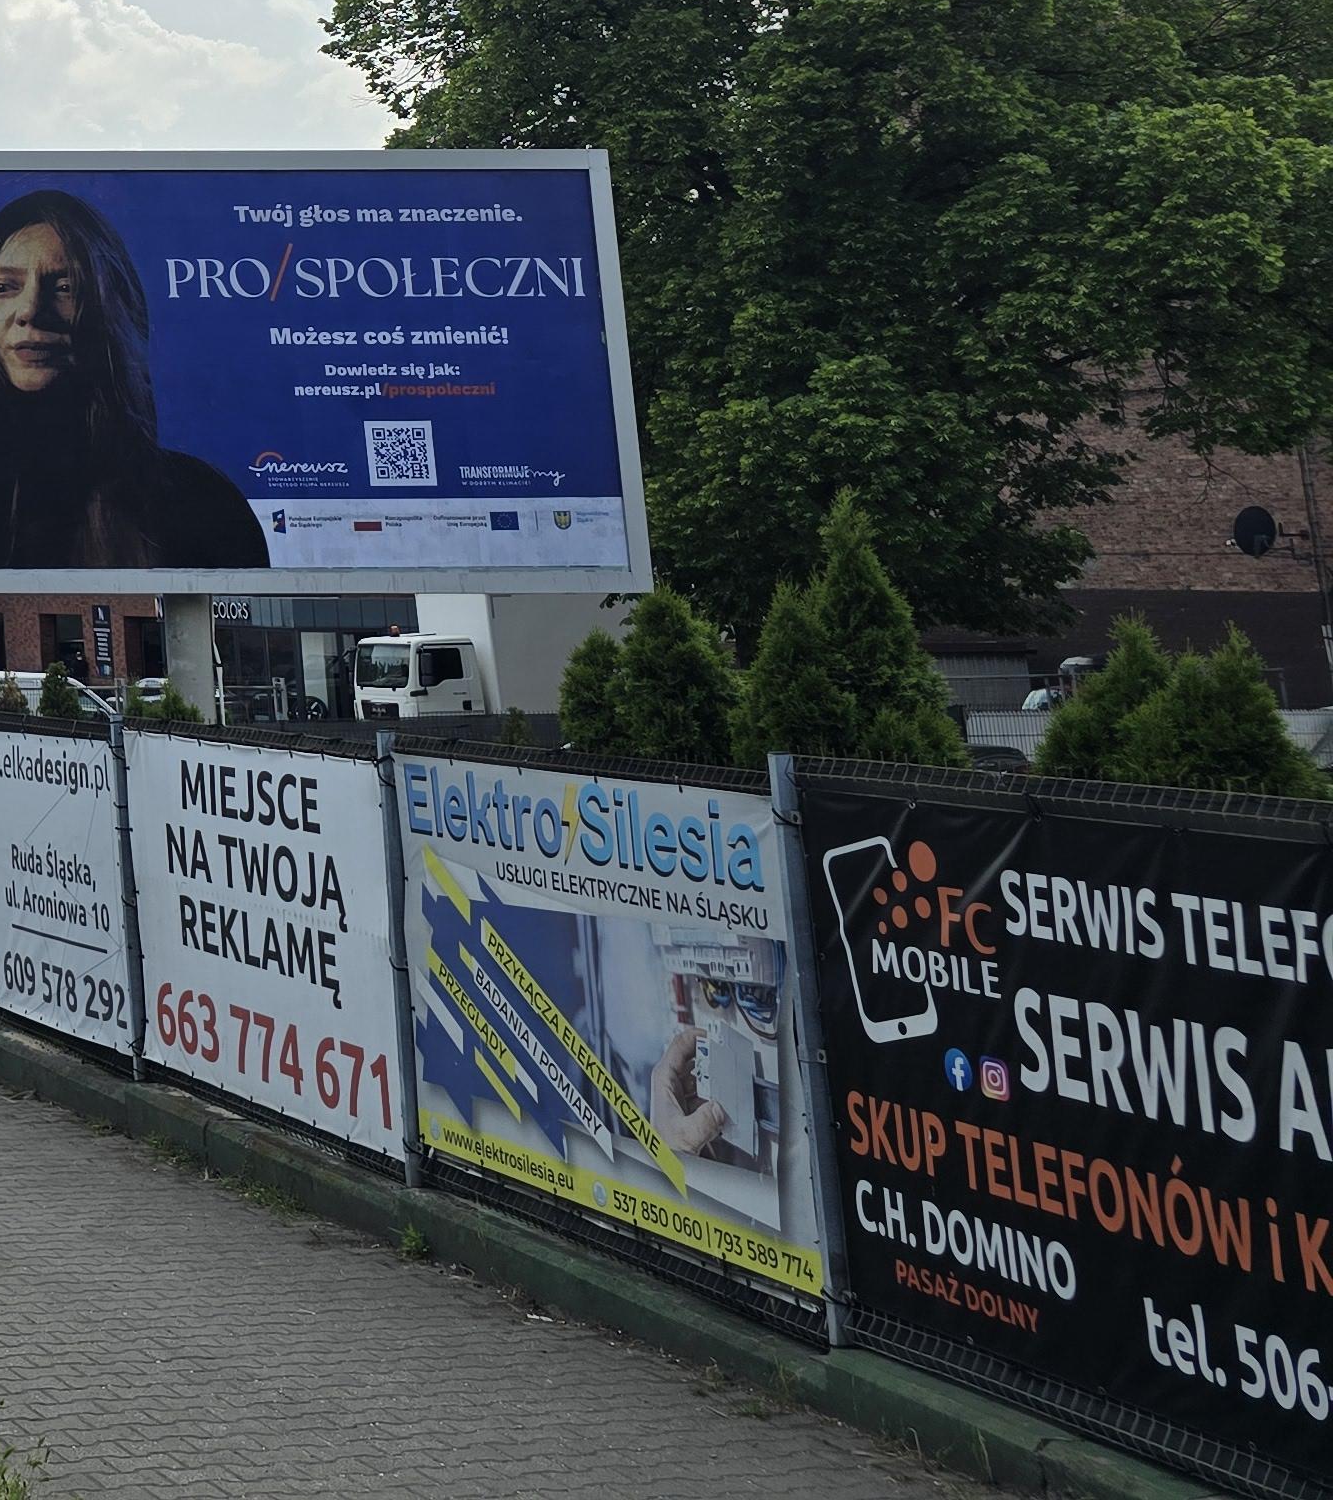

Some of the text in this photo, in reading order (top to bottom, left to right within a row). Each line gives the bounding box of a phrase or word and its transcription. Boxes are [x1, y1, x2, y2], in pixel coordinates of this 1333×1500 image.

[234, 204, 523, 228] Twój głos ma znaczenie.
[270, 325, 509, 346] Możesz coś zmienić!
[324, 363, 460, 379] Dowiedz się jak:
[249, 461, 349, 474] nereusz
[212, 601, 249, 620] COLORS
[180, 759, 321, 834] MIEJSCE
[5, 880, 110, 933] ul. Aroniowa 10
[11, 842, 96, 892] Ruda Śląska,
[166, 823, 348, 933] NA TWOJĄ
[495, 861, 768, 931] USŁUGI ELEKTRYCZNE NA ŚLĄSKU
[179, 894, 342, 1010] REKLAMĘ
[936, 885, 996, 955] FC
[999, 868, 1165, 960] SERWIS
[3, 951, 128, 1030] 609 578 292
[872, 938, 1002, 1000] MOBILE
[438, 963, 508, 1060] PRZEGLĄDY
[487, 932, 661, 1157] PRZYŁĄCZA ELEKTRYCZNE
[156, 982, 392, 1131] 663 774 671
[475, 967, 531, 1048] BADANIA
[539, 1047, 603, 1136] POMIARY
[1013, 987, 1333, 1162] SERWIS A
[443, 1127, 574, 1192] www.elektrosilesia.eu
[613, 1189, 637, 1216] 537
[641, 1199, 669, 1228] 850
[672, 1212, 703, 1242] 060
[713, 1227, 743, 1257] 793
[747, 1240, 778, 1269] 589
[781, 1252, 815, 1282] 774
[847, 1090, 1333, 1297] SKUP TELEFONÓW i K
[855, 1179, 1077, 1301] C.H. DOMINO
[895, 1259, 1039, 1334] PASAŻ DOLNY
[1143, 1296, 1333, 1421] tel. 506
